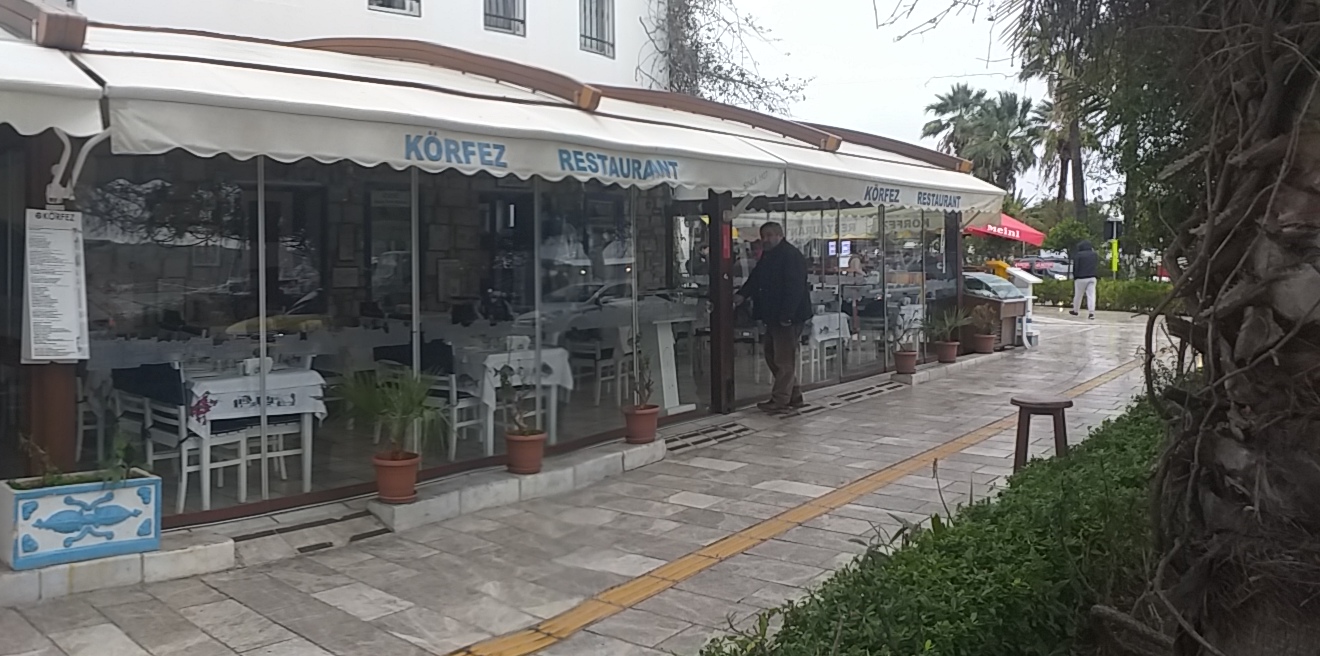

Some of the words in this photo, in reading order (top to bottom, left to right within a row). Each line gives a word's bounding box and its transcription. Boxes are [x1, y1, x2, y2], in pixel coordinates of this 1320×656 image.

[404, 131, 508, 168] KÖRFEZ
[558, 148, 678, 180] RESTAURANT
[864, 184, 900, 202] KÖRFEZ
[917, 191, 962, 209] RESTAURANT
[987, 224, 1021, 238] Meinl
